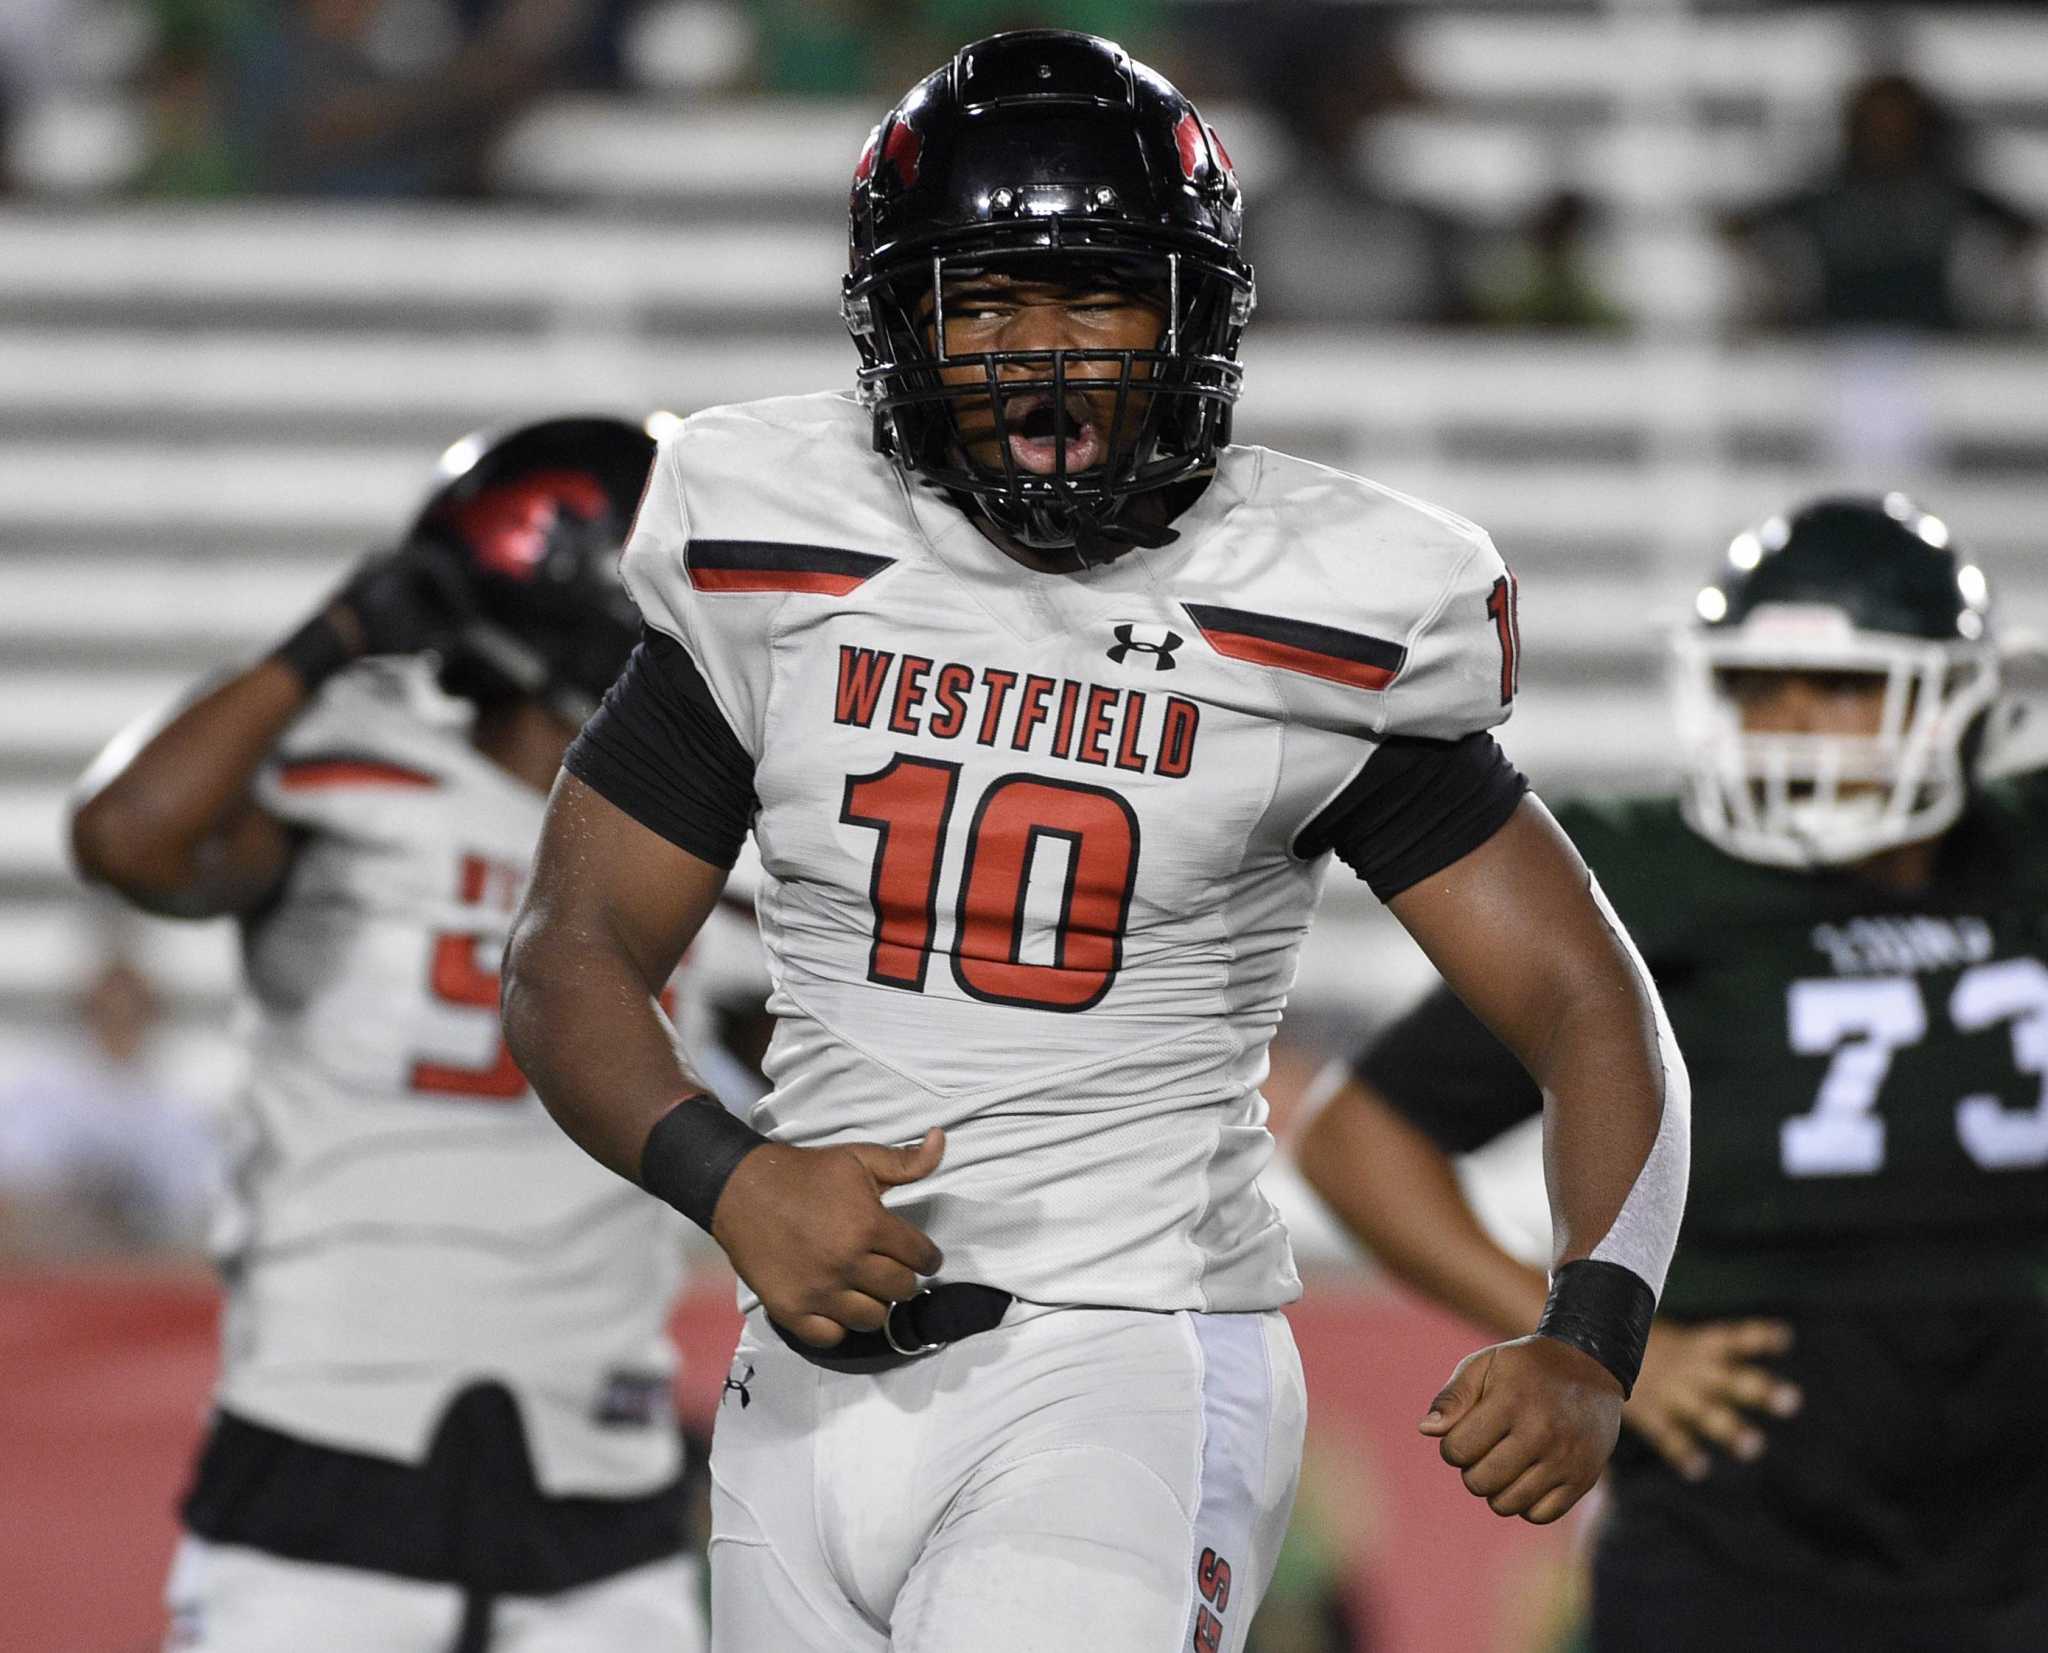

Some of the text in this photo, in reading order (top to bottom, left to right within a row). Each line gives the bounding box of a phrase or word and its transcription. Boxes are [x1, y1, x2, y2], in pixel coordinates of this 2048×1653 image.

[834, 645, 1200, 778] WESTFIELD
[1486, 575, 1520, 707] 1
[839, 752, 1140, 1013] 10
[1780, 957, 2048, 1178] 73
